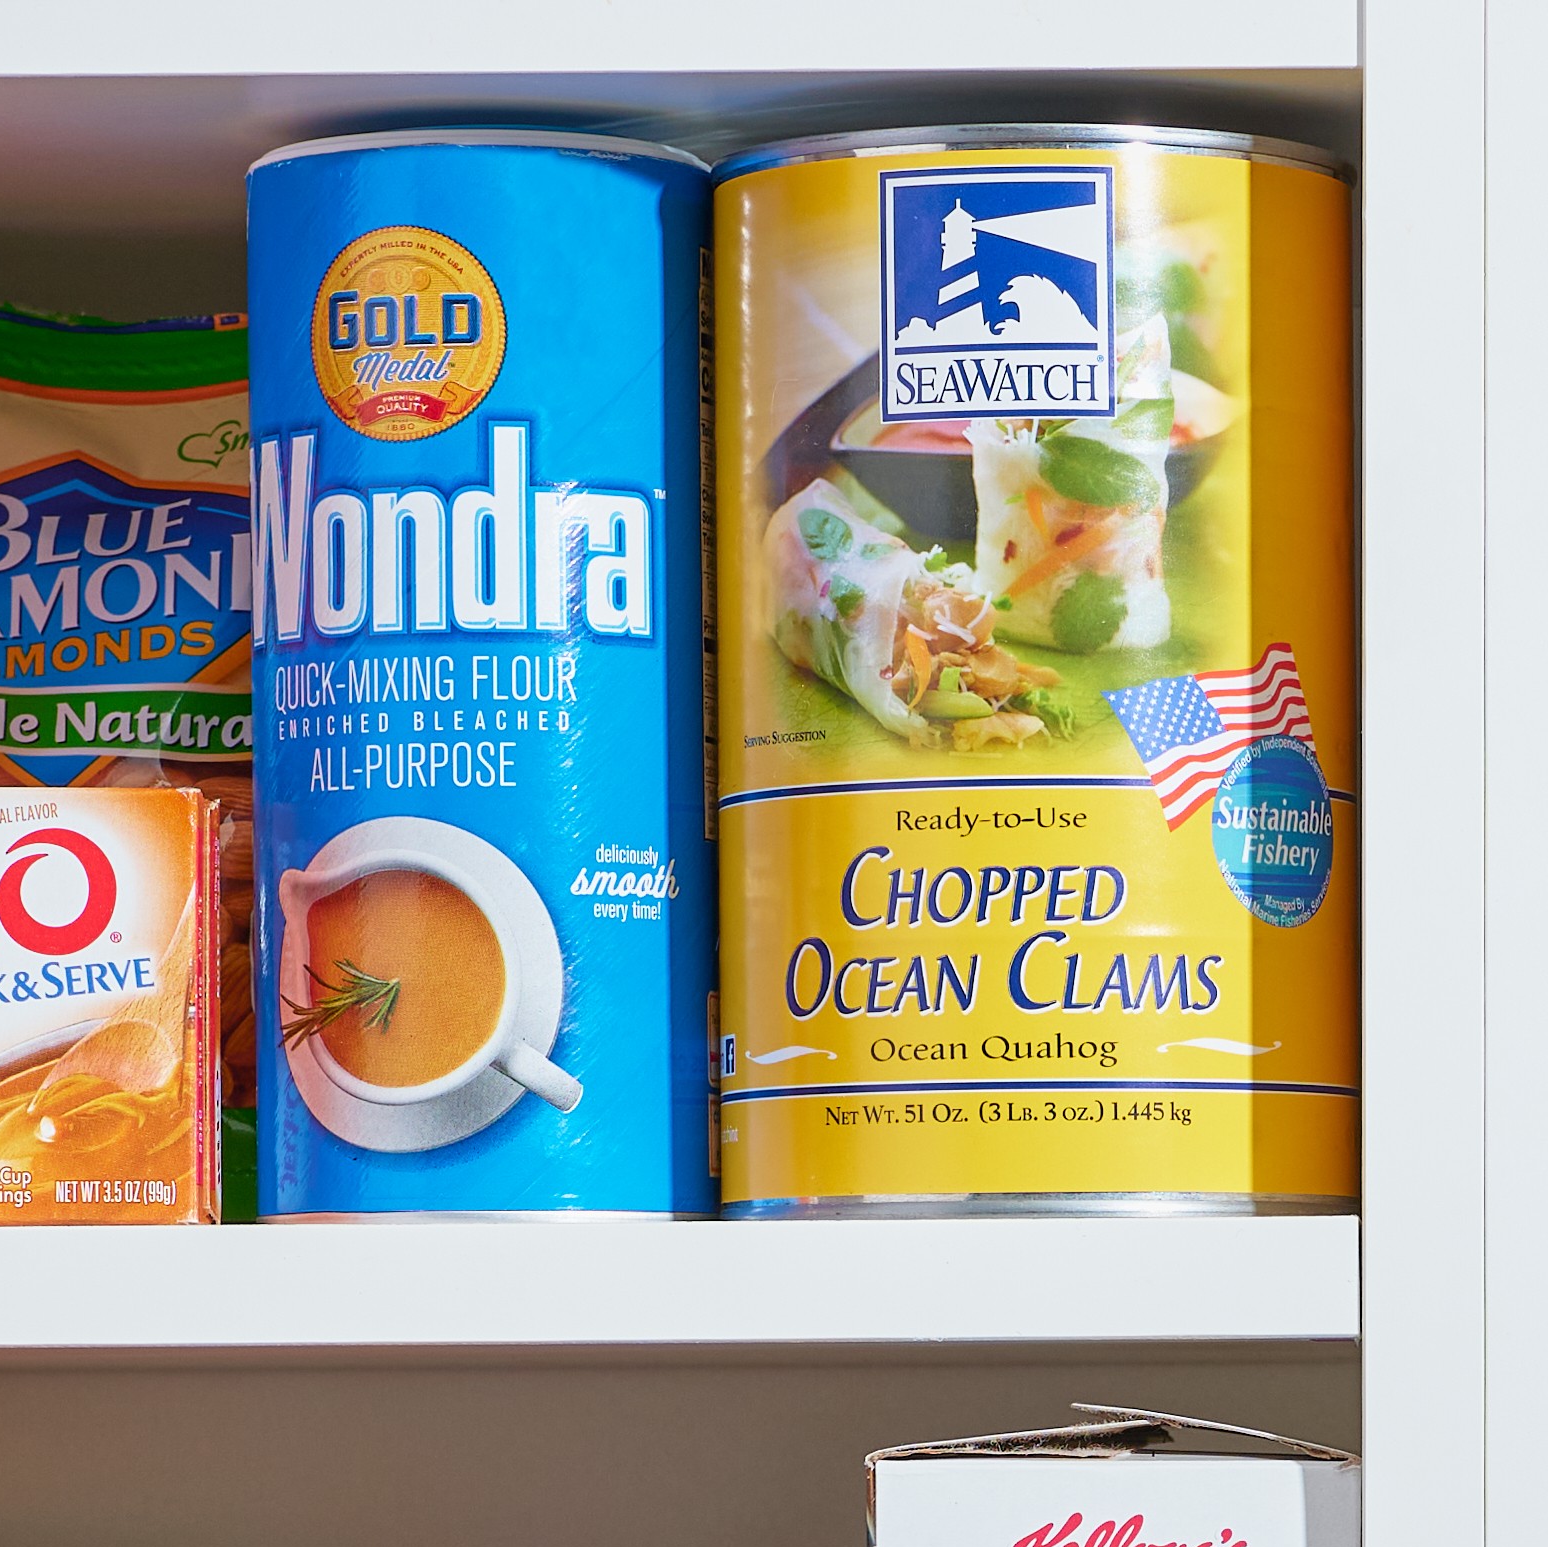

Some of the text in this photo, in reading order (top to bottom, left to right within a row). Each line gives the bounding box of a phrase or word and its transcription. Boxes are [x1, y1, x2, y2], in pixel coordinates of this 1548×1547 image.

[329, 291, 484, 350] GOLD
[896, 359, 1099, 406] SEAWATCH
[252, 420, 653, 650] Wondra
[310, 741, 517, 793] ALL-PURPOSE
[895, 807, 1088, 836] Ready-to-Use
[1218, 797, 1332, 838] Sustainable
[595, 844, 659, 867] deliciously
[1241, 834, 1320, 873] Fishery
[571, 859, 679, 899] smooth
[840, 845, 1128, 929] CHOPPED
[784, 930, 1224, 1020] OCEAN CLAMS
